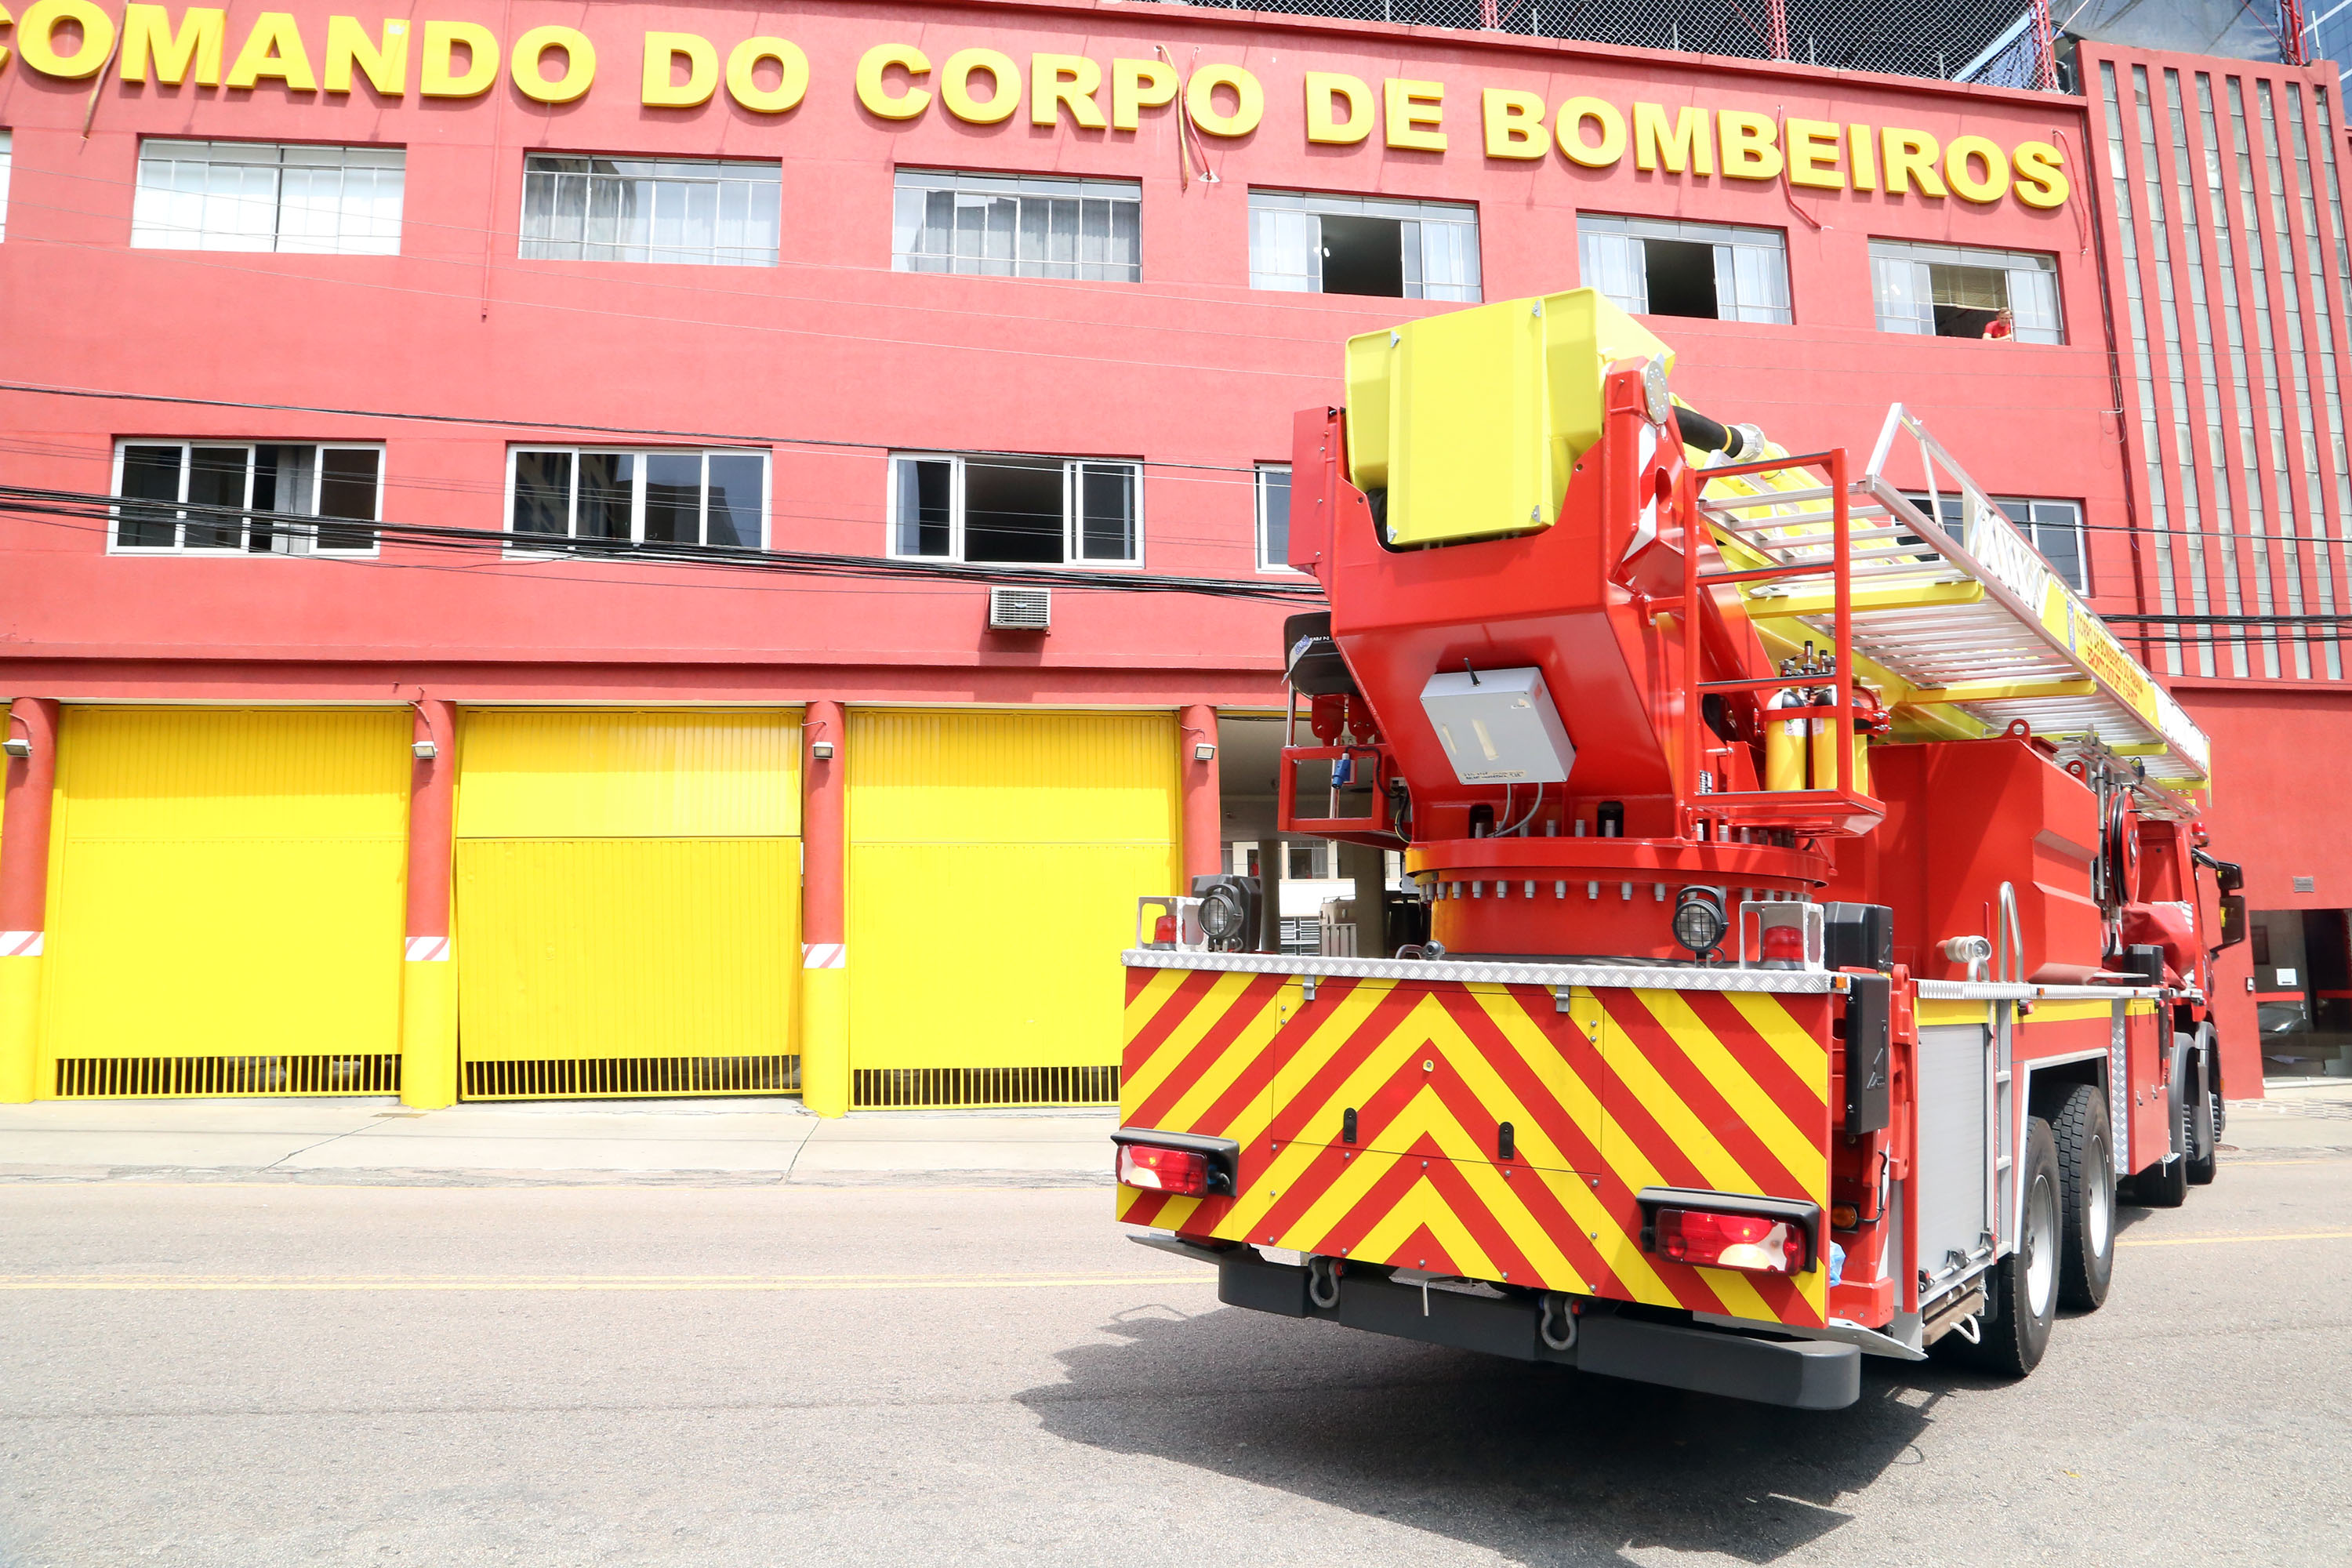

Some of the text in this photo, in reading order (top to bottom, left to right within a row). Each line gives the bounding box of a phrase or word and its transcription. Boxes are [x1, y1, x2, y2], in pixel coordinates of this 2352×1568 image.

[0, 0, 2071, 209] OMANDO DO CORPO DE BOMBEIROS
